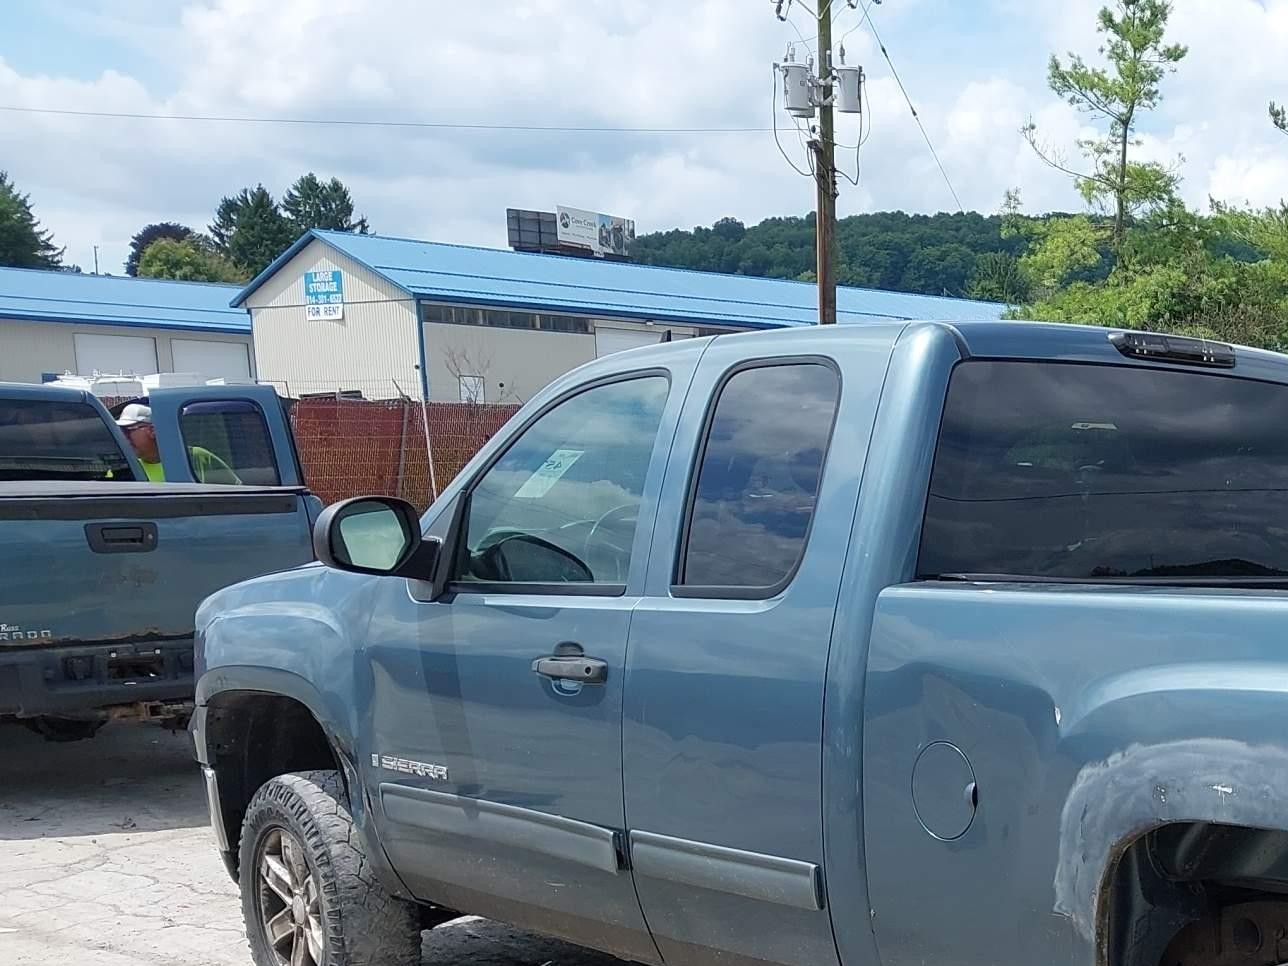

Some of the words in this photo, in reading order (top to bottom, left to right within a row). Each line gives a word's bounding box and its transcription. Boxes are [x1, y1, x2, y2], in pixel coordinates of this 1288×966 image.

[312, 271, 333, 282] LARGE
[309, 282, 338, 293] STORAGE
[307, 306, 321, 317] FOR
[323, 306, 341, 316] RENT
[381, 755, 449, 780] SIERRA
